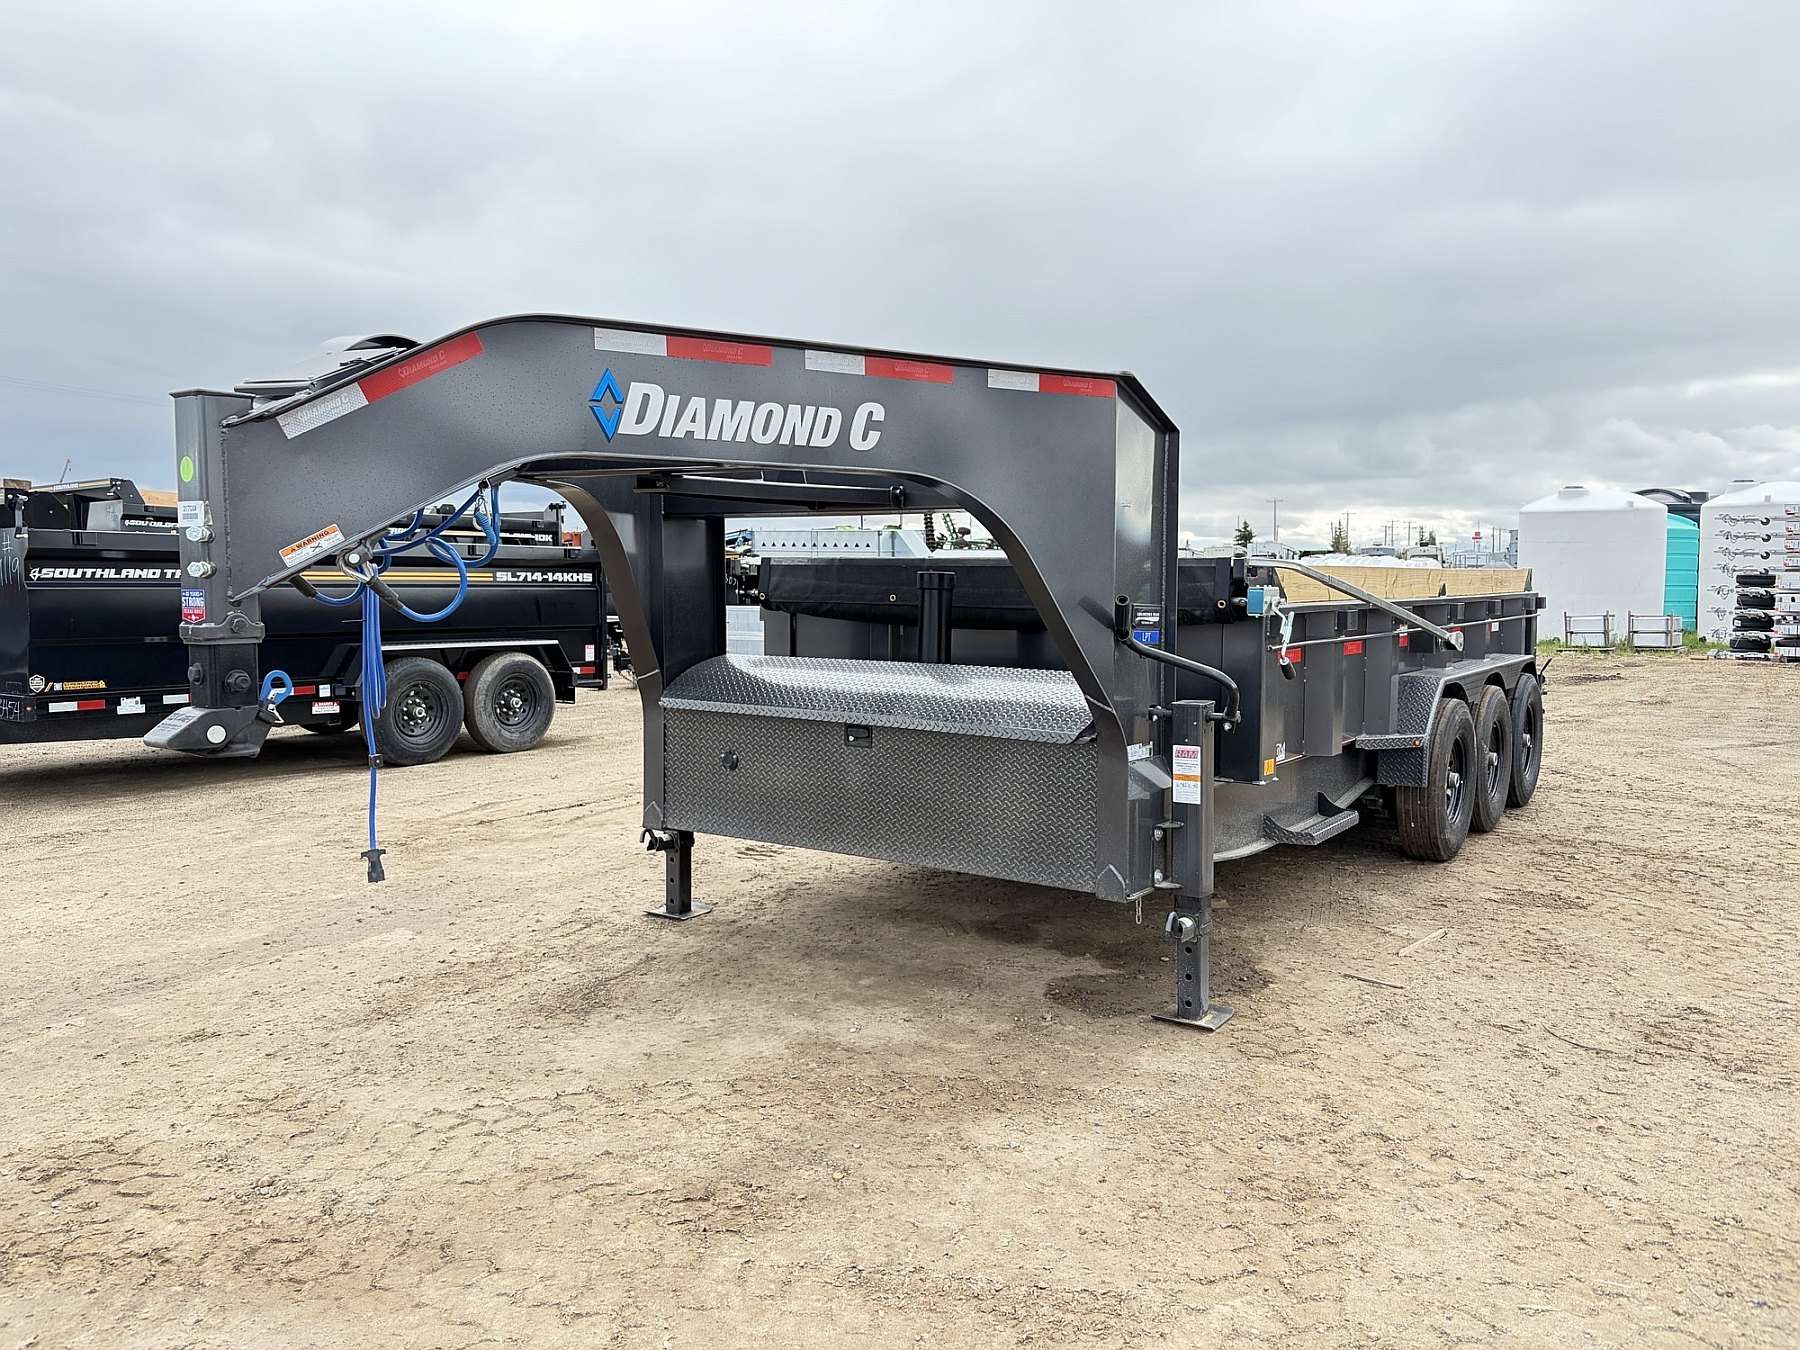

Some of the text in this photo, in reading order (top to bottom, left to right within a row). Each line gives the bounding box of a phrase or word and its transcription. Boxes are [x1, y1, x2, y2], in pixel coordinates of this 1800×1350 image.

[618, 382, 885, 450] DIAMOND C
[295, 530, 329, 549] WARNING
[40, 568, 161, 579] SOUTHLAND
[496, 572, 592, 582] SL714-14KHS
[182, 597, 205, 607] STRONG
[1174, 750, 1199, 760] RAM
